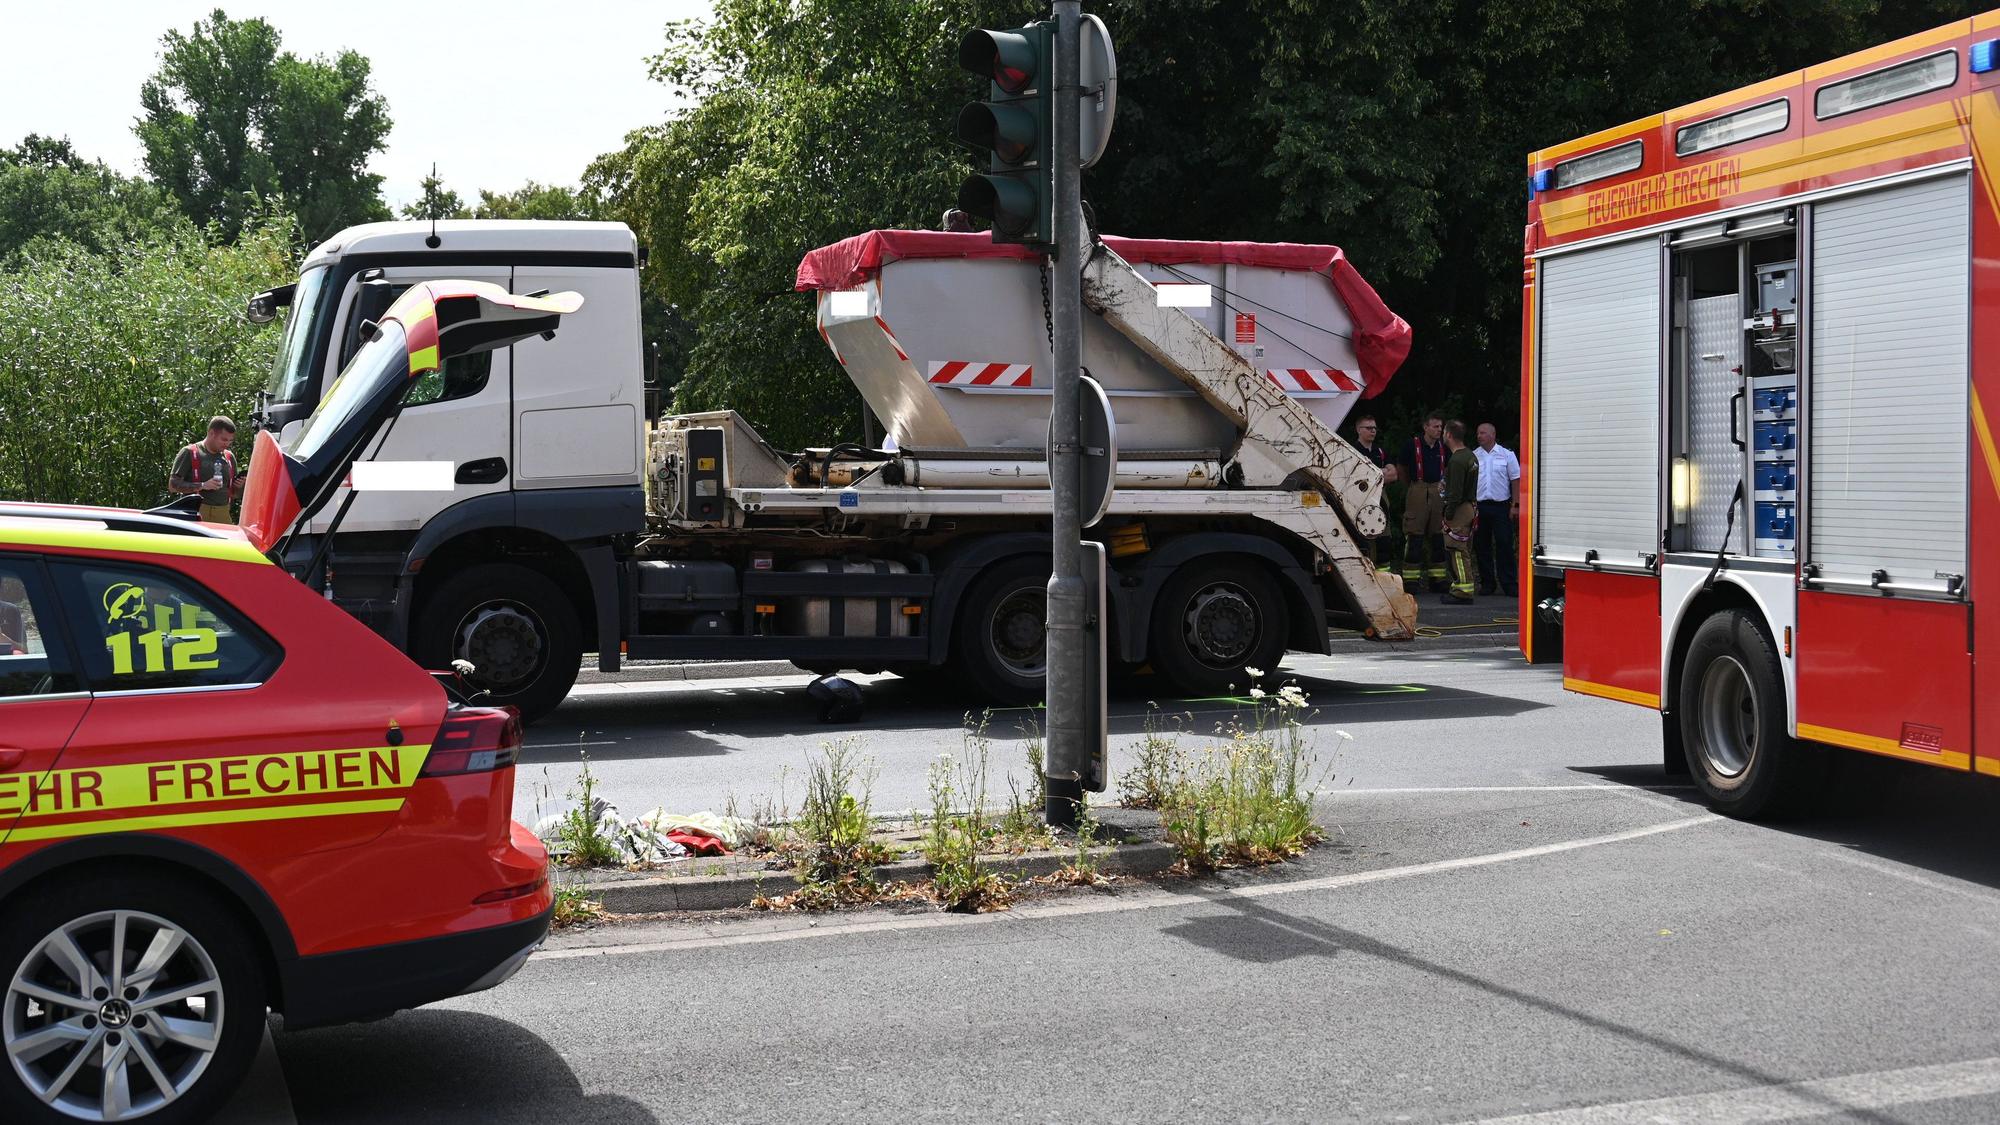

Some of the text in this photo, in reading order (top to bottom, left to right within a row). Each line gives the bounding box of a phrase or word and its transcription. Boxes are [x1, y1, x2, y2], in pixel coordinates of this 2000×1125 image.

[1588, 158, 1741, 226] FEUERWEHR FRECHEN
[106, 628, 219, 674] 112
[0, 750, 402, 815] EHR FRECHEN
